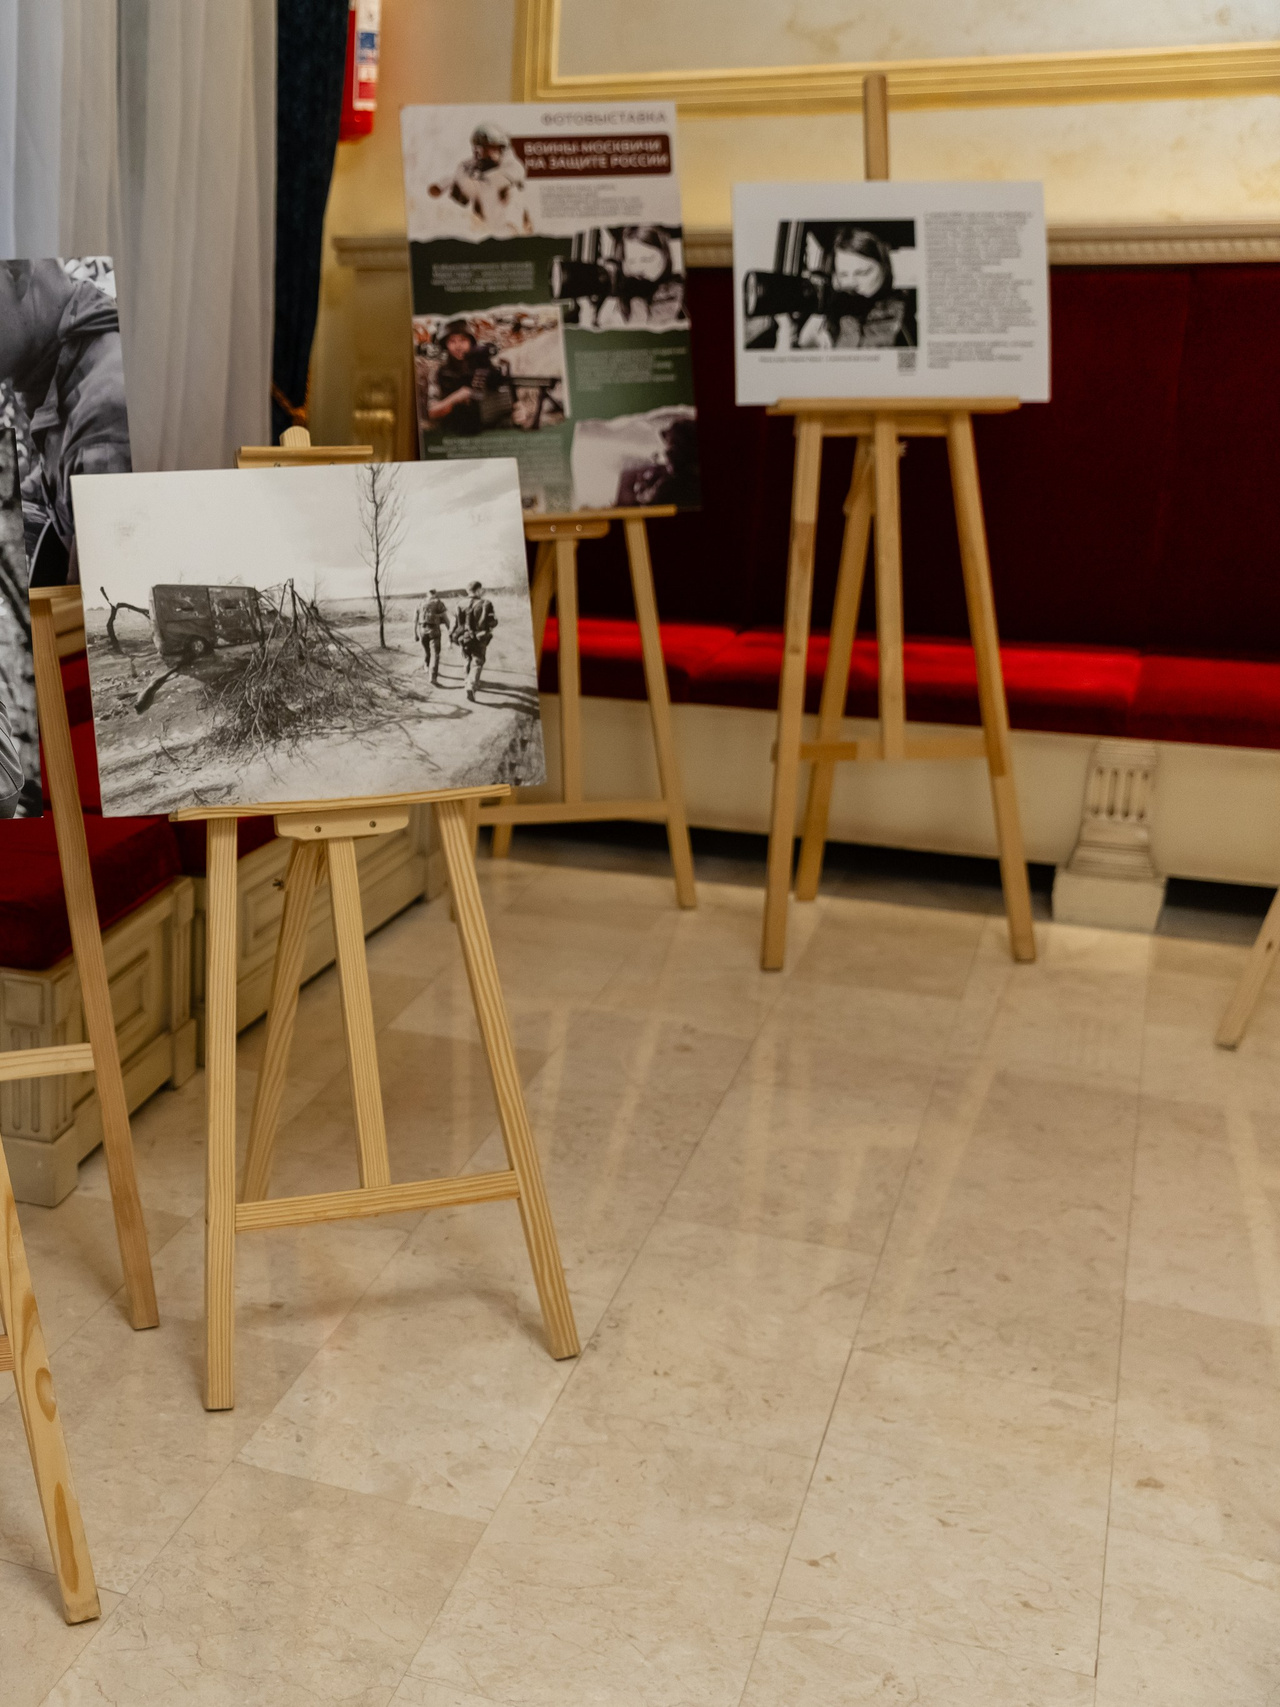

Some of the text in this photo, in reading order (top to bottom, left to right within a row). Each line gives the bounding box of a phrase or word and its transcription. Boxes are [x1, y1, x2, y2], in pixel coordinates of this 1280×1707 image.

[541, 112, 667, 126] ФОТОВЫСТАВКА
[548, 154, 609, 170] ЗАЩИТЕ
[610, 152, 668, 168] РОССИИ
